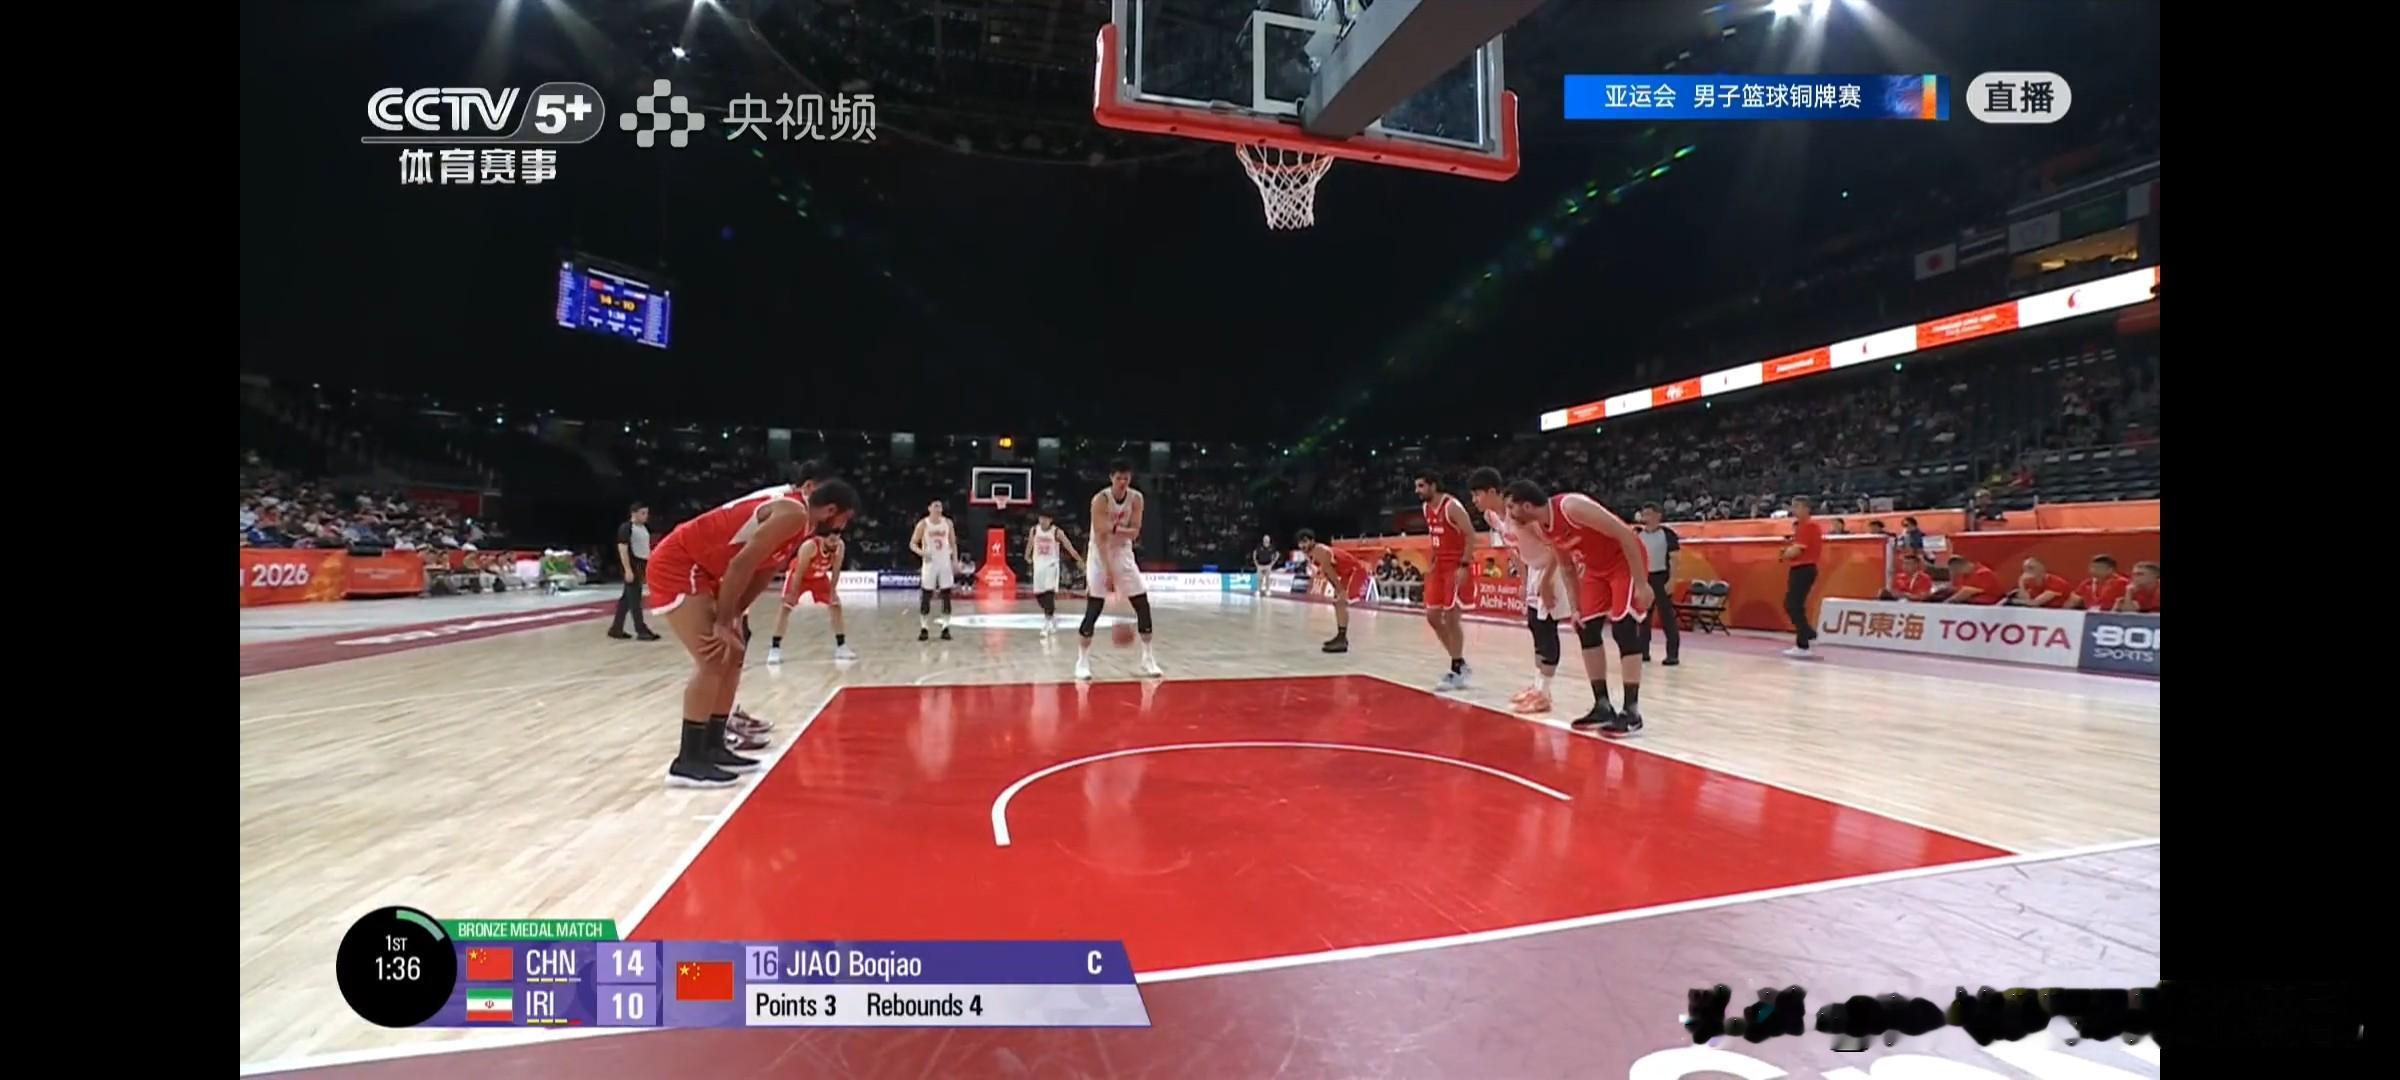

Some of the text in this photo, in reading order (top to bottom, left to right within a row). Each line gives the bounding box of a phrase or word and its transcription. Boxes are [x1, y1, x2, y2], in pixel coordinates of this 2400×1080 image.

[252, 563, 309, 587] 2026
[1822, 609, 1926, 641] JR東海
[1939, 619, 2072, 650] TOYOTA
